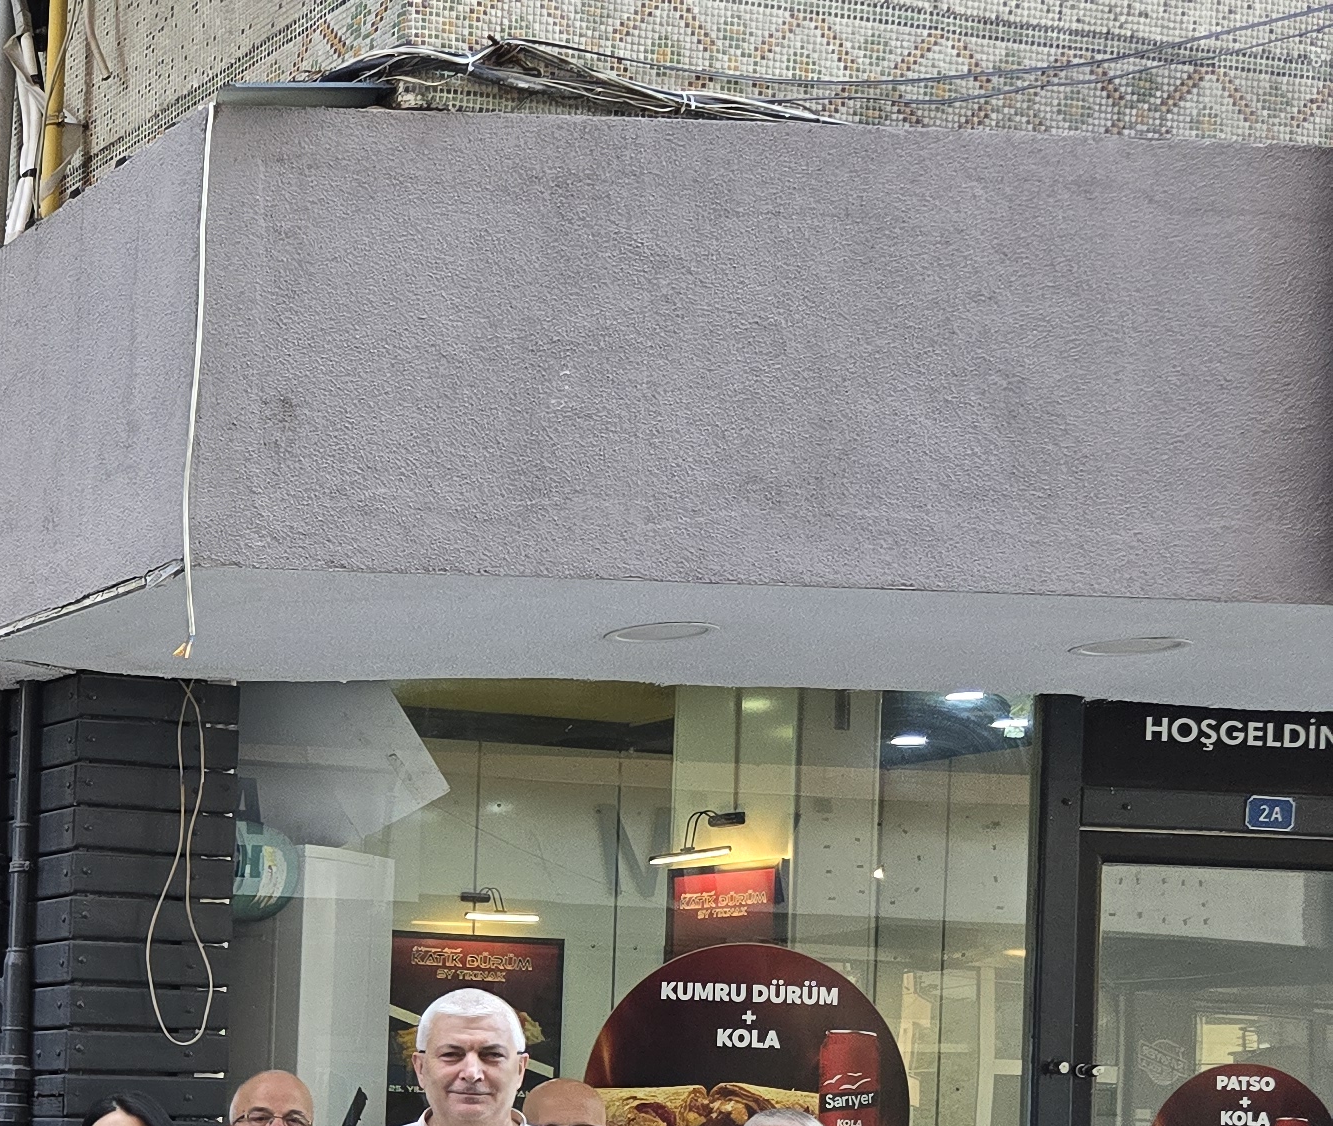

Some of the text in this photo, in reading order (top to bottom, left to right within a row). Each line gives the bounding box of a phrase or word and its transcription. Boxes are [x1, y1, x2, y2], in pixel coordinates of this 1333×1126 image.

[1258, 805, 1283, 822] 2A
[466, 952, 533, 971] DÜRÜM
[660, 979, 839, 1006] KUMRU DÜRÜM
[716, 1028, 781, 1049] KOLA
[1216, 1075, 1276, 1092] PATSO
[1220, 1110, 1271, 1126] KOLA
